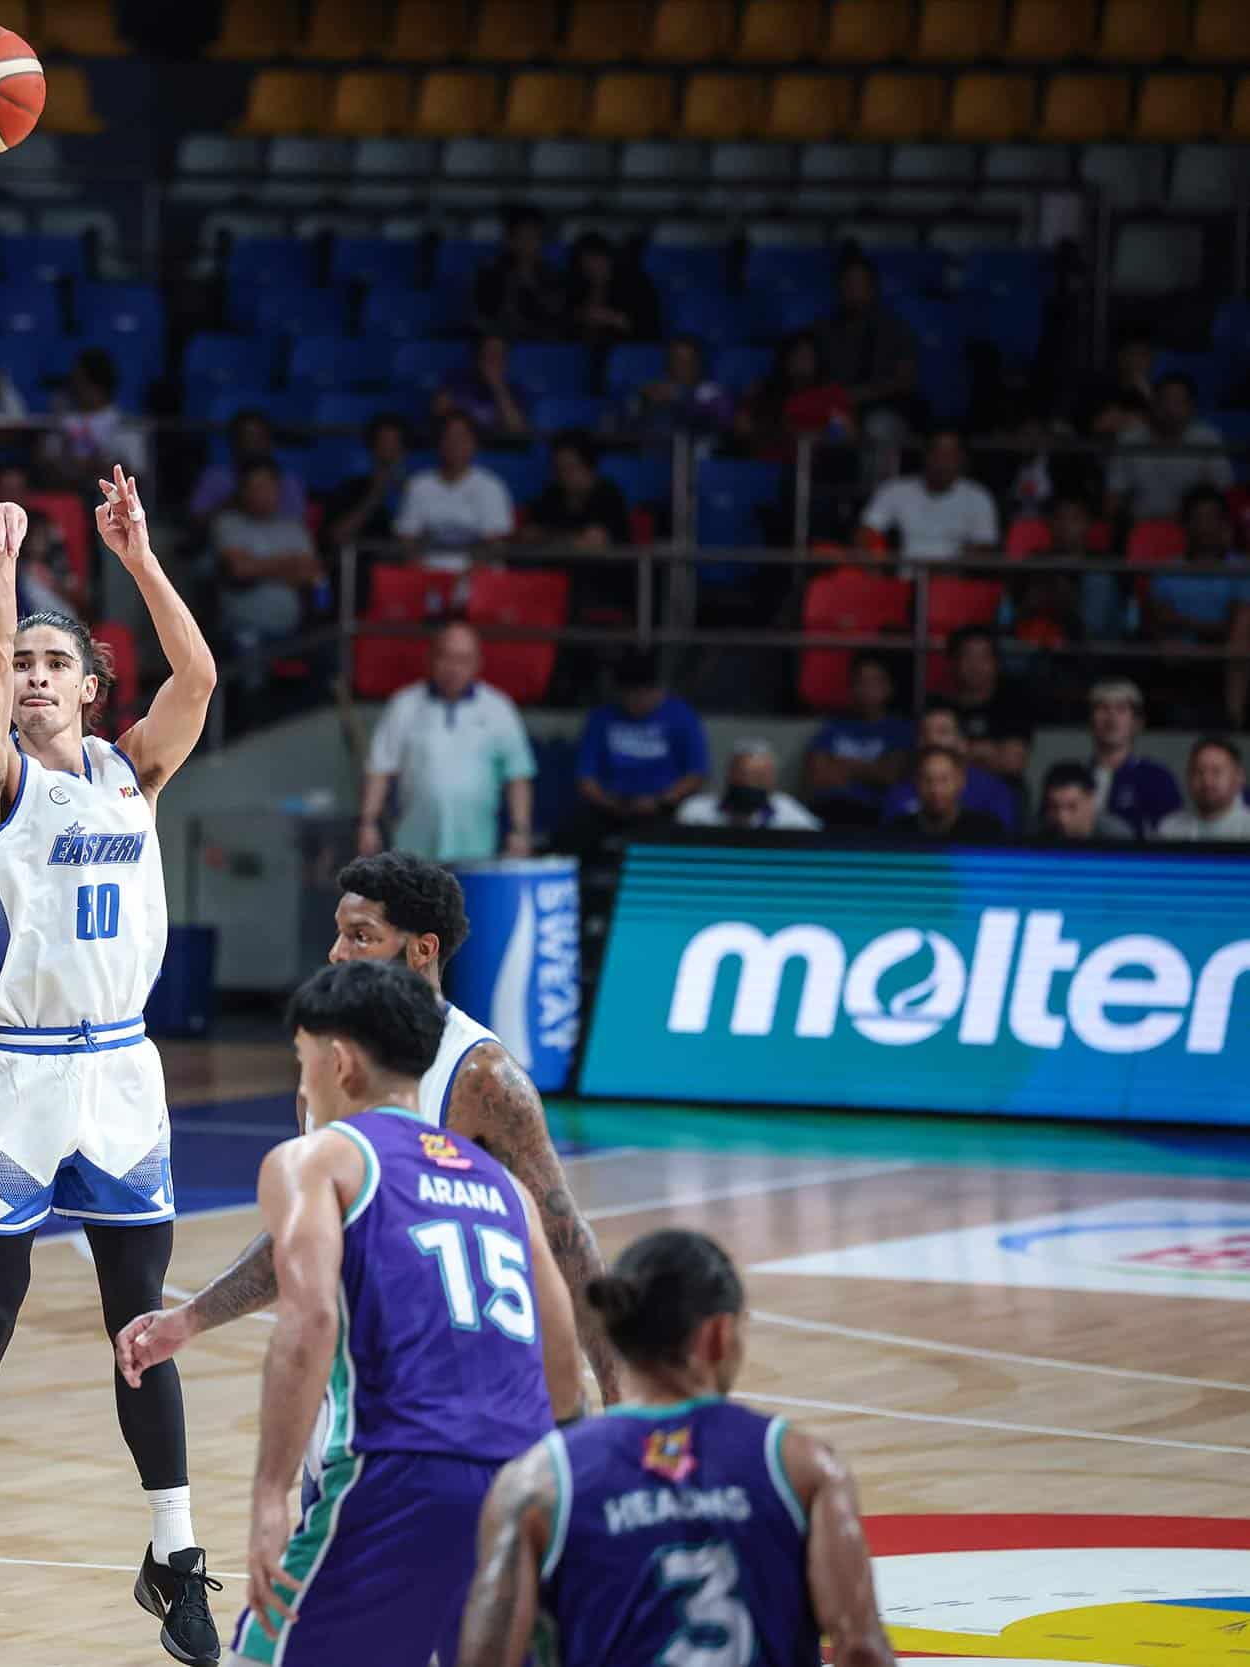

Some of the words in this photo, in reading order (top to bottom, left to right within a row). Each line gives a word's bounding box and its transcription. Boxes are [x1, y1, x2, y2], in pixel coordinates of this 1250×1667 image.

[47, 831, 147, 866] EASTERN
[76, 882, 120, 940] 80
[419, 1173, 508, 1216] ARANA
[407, 1218, 535, 1344] 15
[656, 1543, 756, 1667] 3
